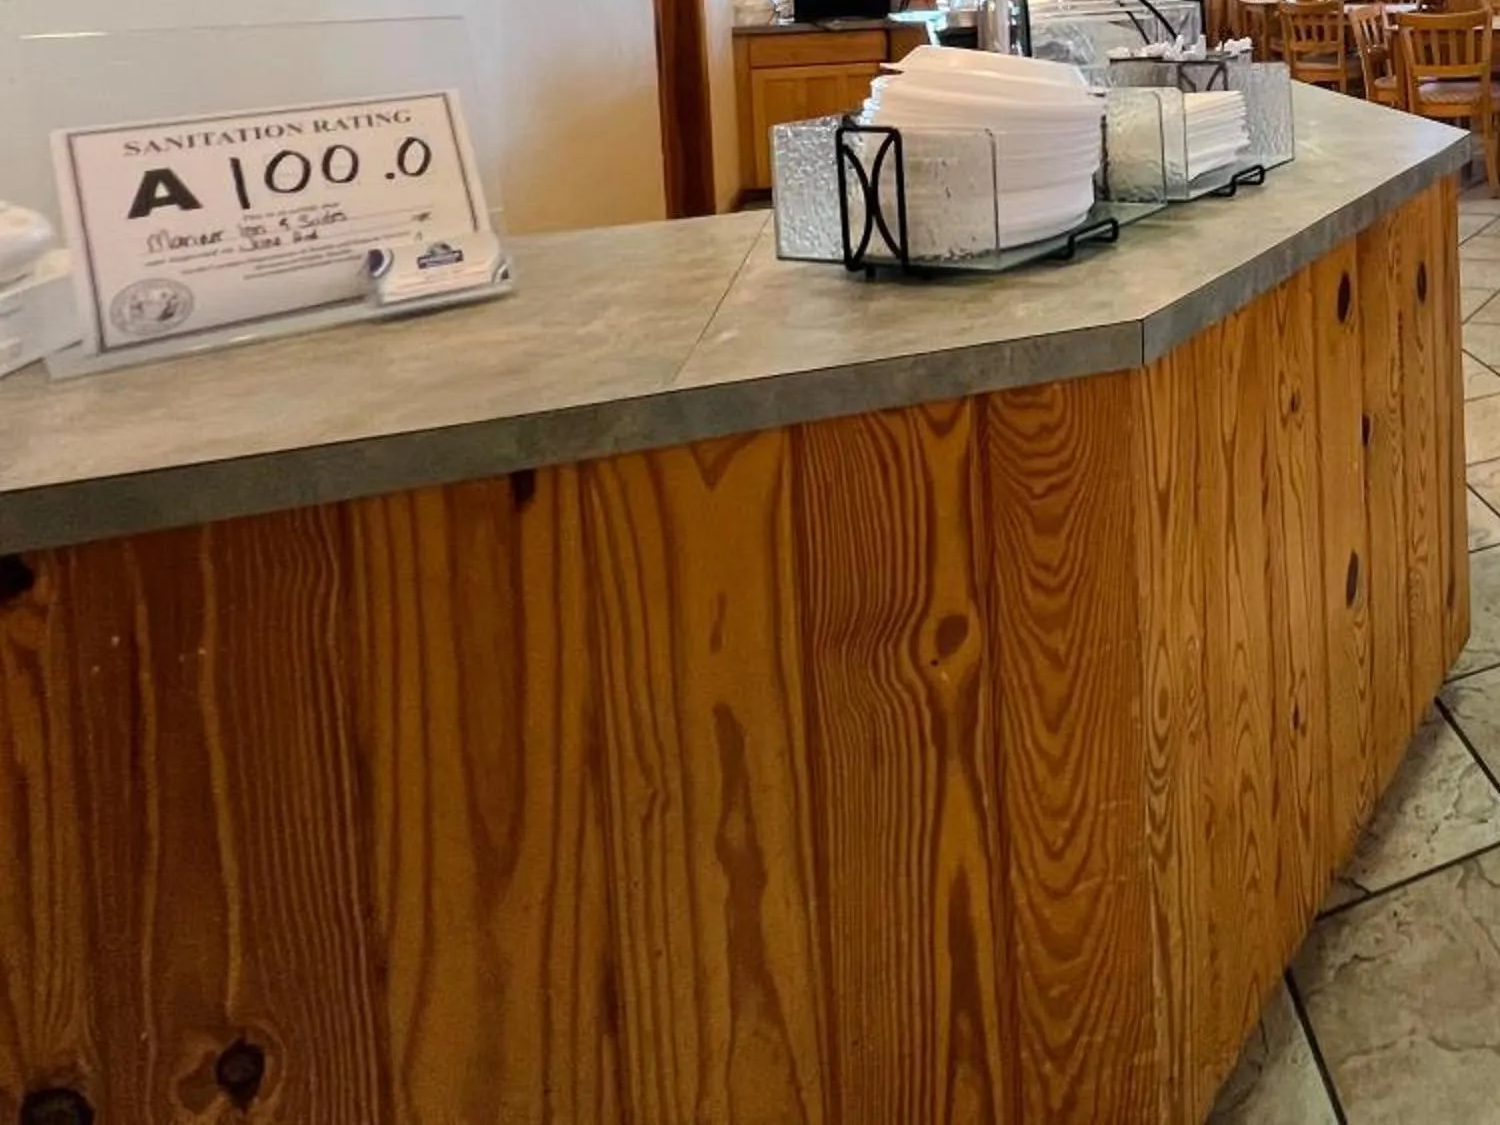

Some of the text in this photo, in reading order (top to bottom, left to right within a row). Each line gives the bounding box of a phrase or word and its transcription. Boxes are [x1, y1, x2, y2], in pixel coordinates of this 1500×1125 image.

[123, 108, 413, 157] SANITATION RATING
[127, 167, 204, 220] A
